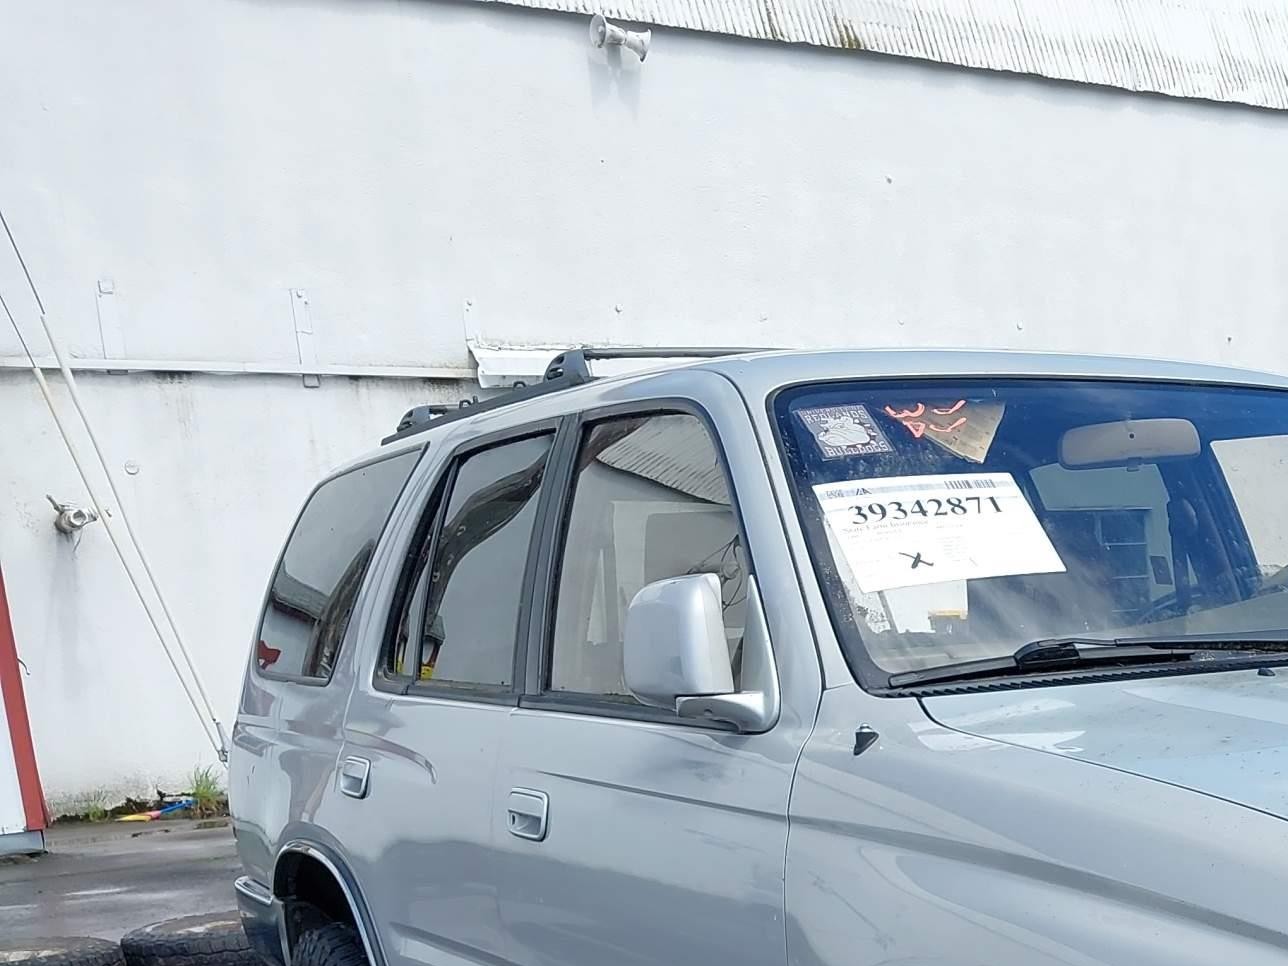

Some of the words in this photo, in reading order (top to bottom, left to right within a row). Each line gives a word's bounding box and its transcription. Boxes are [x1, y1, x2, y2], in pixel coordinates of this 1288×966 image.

[804, 409, 869, 425] REDLANDS
[823, 440, 889, 458] BULLDOGS
[847, 495, 1003, 525] 39342871
